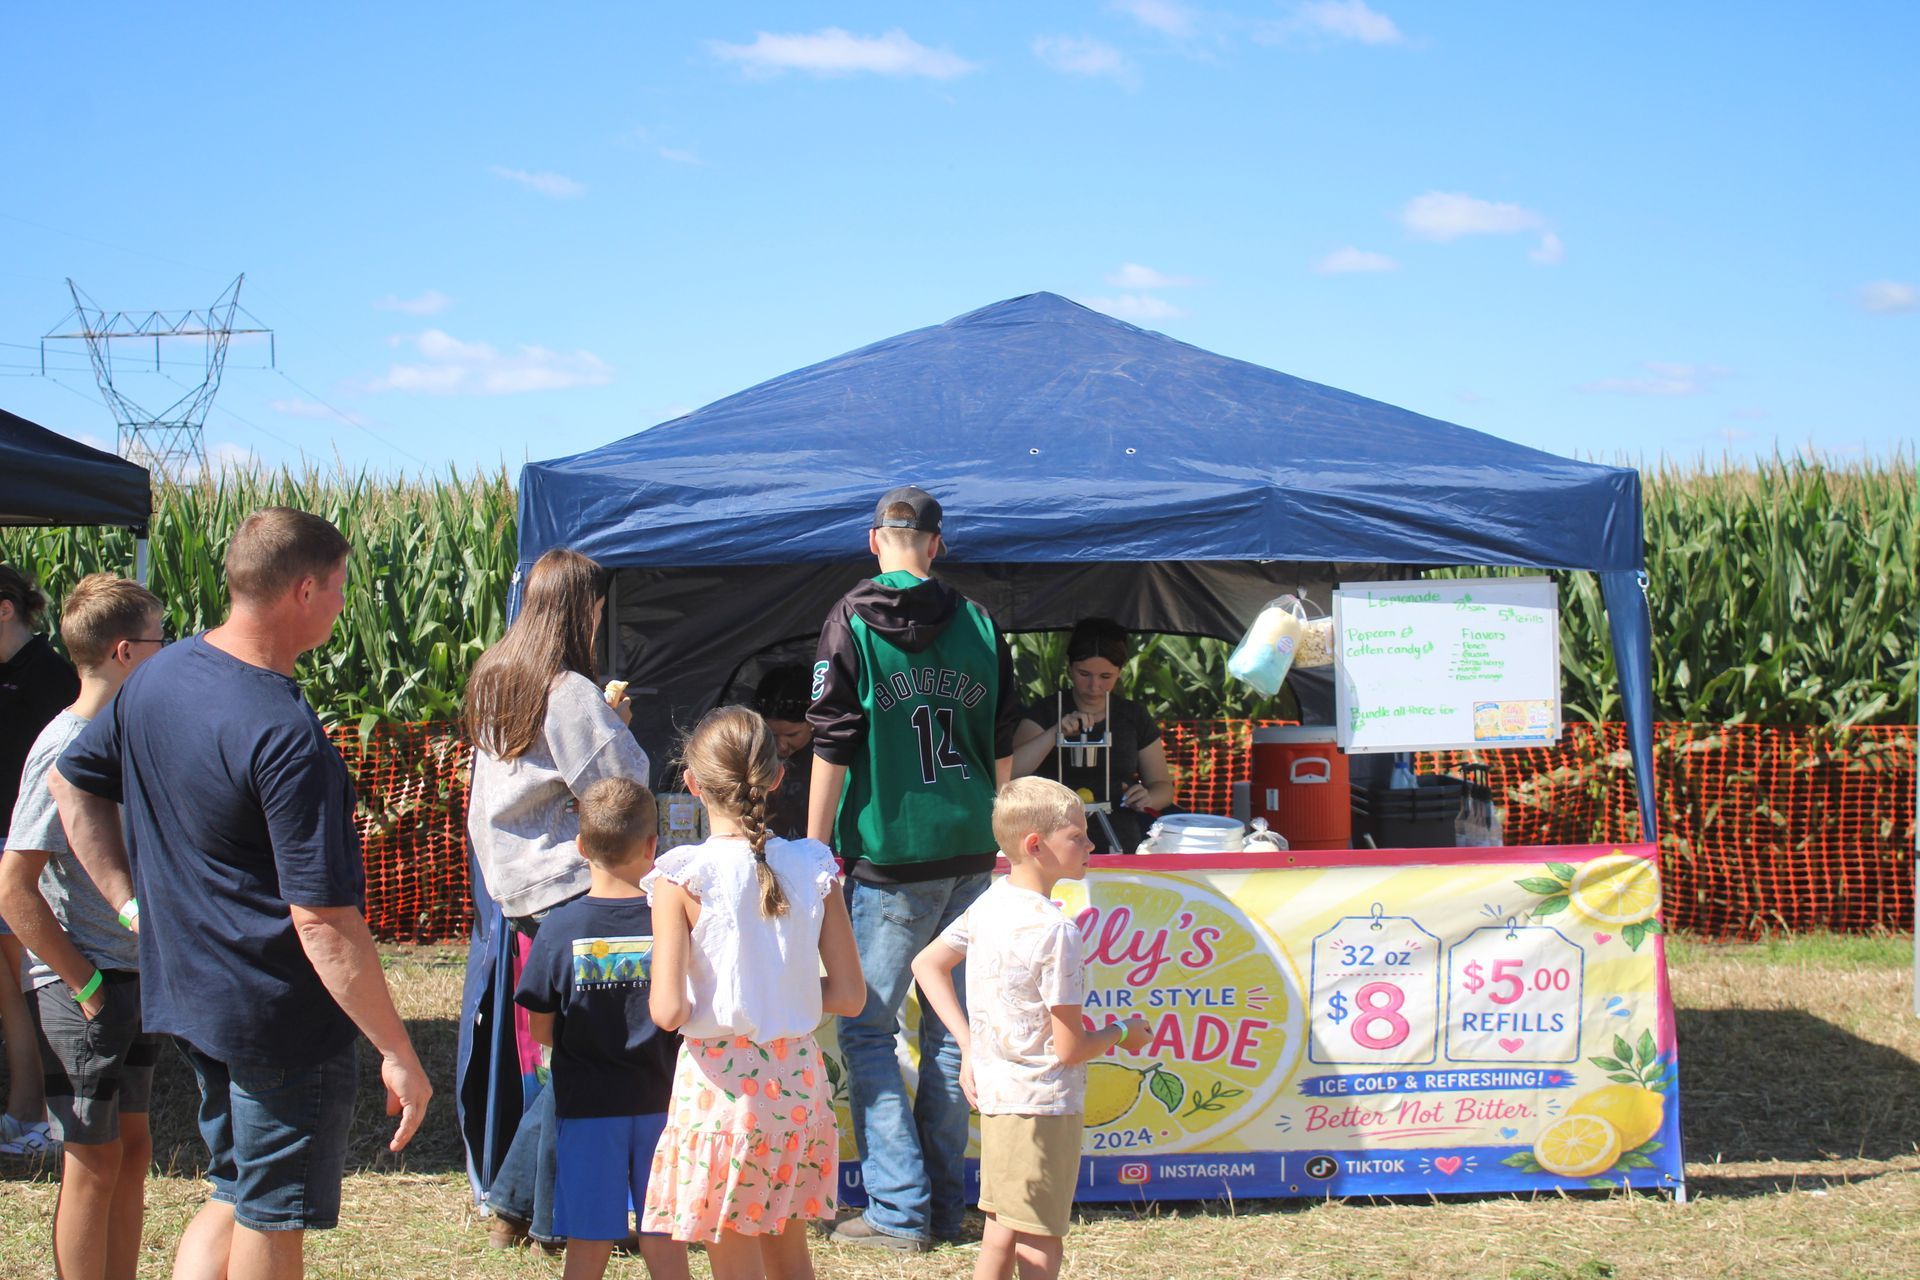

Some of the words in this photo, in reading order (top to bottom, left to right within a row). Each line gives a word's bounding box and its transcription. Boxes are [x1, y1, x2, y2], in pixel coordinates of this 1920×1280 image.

[1367, 591, 1441, 608] Lemonade
[1345, 627, 1397, 641] Popcorn
[1461, 627, 1505, 640] Flavors
[1387, 643, 1421, 660] candy
[1350, 706, 1390, 719] Bundle
[1075, 907, 1221, 987] lly's
[1340, 945, 1375, 966] 32
[1462, 959, 1571, 1005] $5.00
[1084, 989, 1133, 1008] AIR
[1149, 988, 1236, 1007] STYLE
[1327, 981, 1410, 1050] $8
[1461, 1012, 1564, 1032] REFILLS
[1319, 1079, 1348, 1093] ICE
[1353, 1076, 1398, 1092] COLD
[1404, 1075, 1418, 1090] &
[1425, 1071, 1545, 1089] REFRESHING!
[1305, 1104, 1388, 1133] Better
[1396, 1100, 1445, 1125] Not
[1454, 1097, 1538, 1124] Bitter.
[1093, 1128, 1153, 1150] 2024
[1159, 1163, 1256, 1179] INSTAGRAM
[1345, 1158, 1406, 1175] TIKTOK
